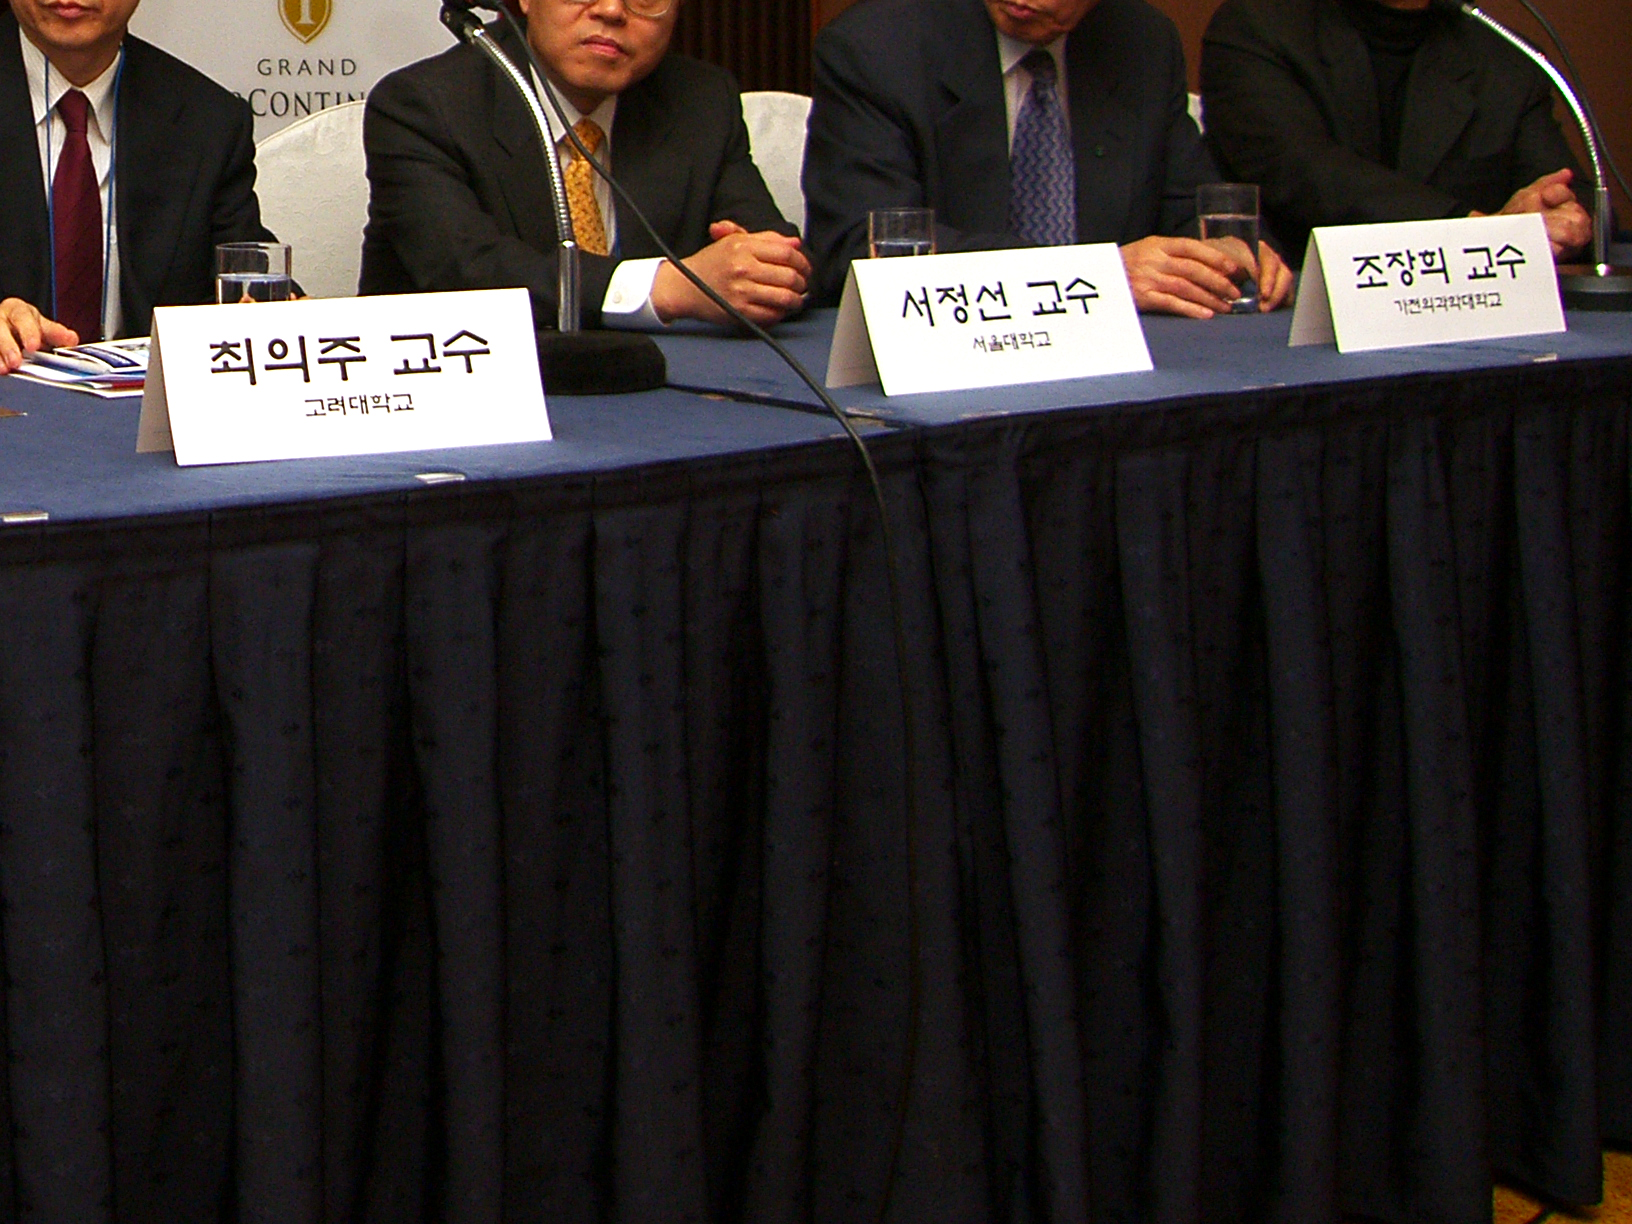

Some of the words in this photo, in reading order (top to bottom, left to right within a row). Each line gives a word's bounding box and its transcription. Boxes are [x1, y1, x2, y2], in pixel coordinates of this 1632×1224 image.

[257, 58, 357, 76] GRAND
[1352, 247, 1450, 289] 조장희
[1462, 244, 1526, 280] 교수
[902, 281, 1012, 327] 서정선
[1026, 277, 1100, 316] 교수
[209, 335, 367, 386] 최의주
[390, 329, 491, 376] 교수
[973, 331, 1052, 353] 서울대학교
[304, 393, 414, 417] 고려대학교
